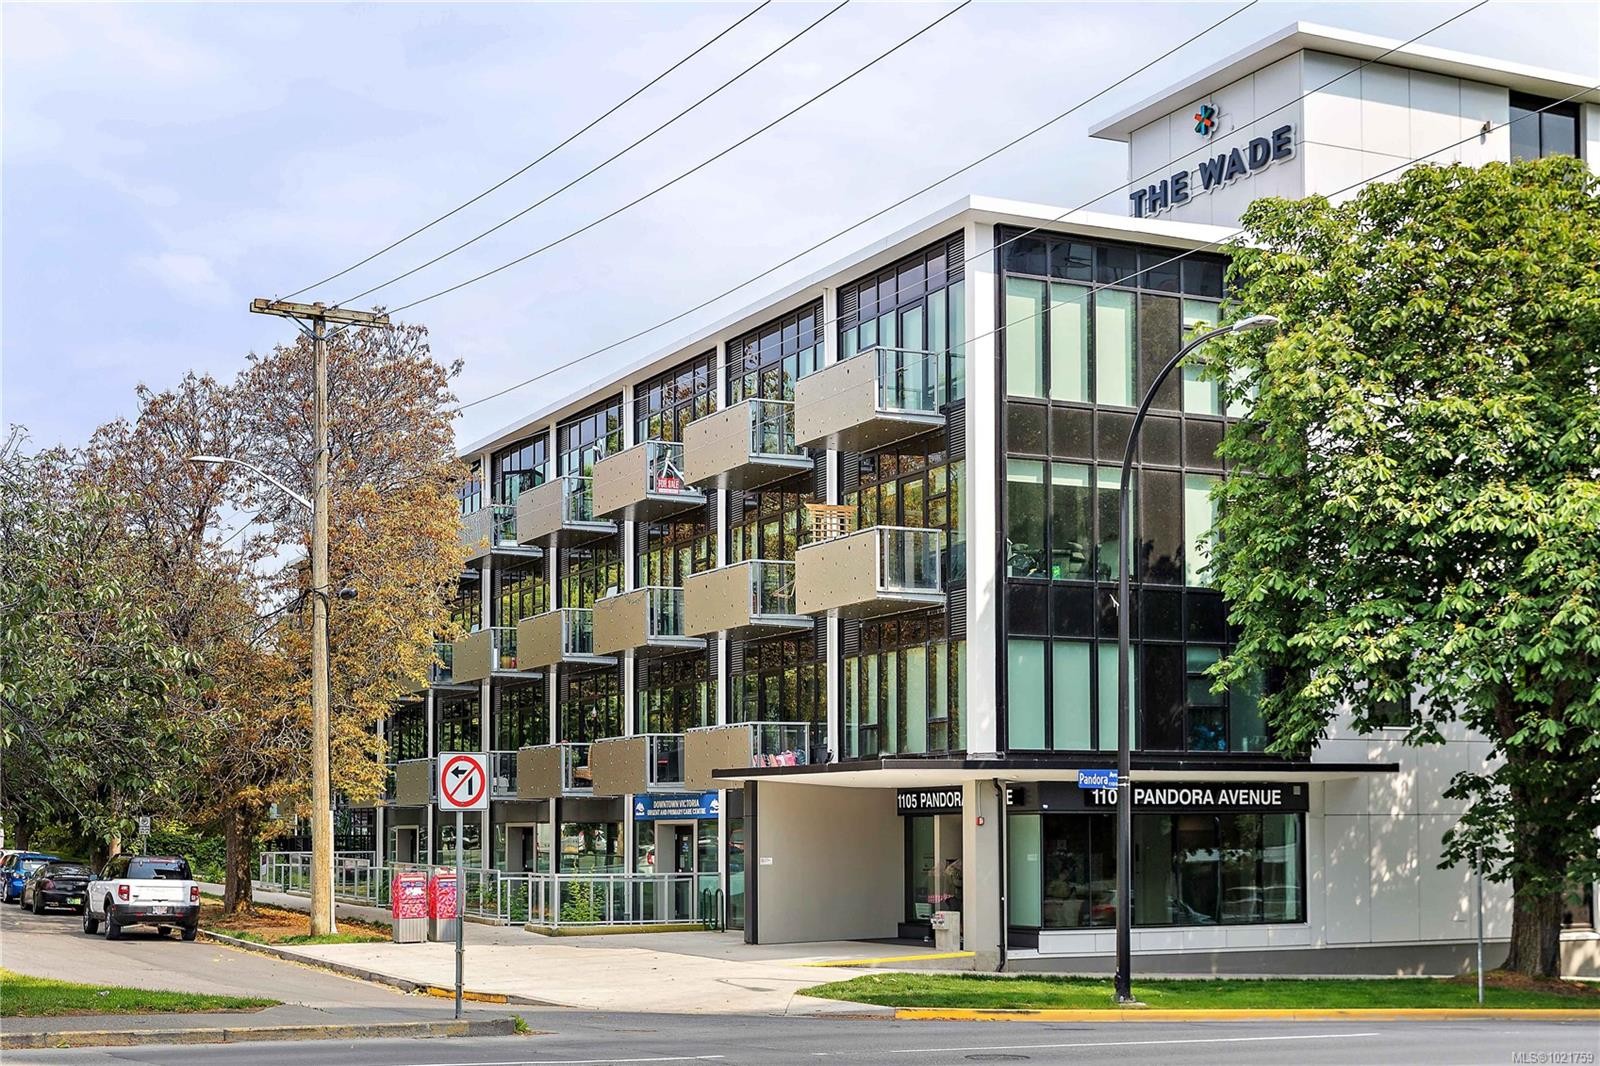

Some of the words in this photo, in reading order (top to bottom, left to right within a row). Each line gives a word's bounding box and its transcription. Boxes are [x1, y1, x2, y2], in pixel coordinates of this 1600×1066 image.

[1129, 170, 1189, 218] THE
[1198, 124, 1293, 190] WADE
[658, 479, 667, 488] FOR
[668, 480, 679, 489] SALE
[1079, 772, 1109, 785] Pandora
[654, 800, 679, 808] DOWNTOWN
[679, 799, 700, 807] VICTORIA
[897, 794, 918, 809] 1105
[920, 791, 963, 808] PANDOR
[1092, 788, 1118, 805] 110
[1134, 788, 1214, 805] PANDORA
[1217, 789, 1282, 805] AVENUE
